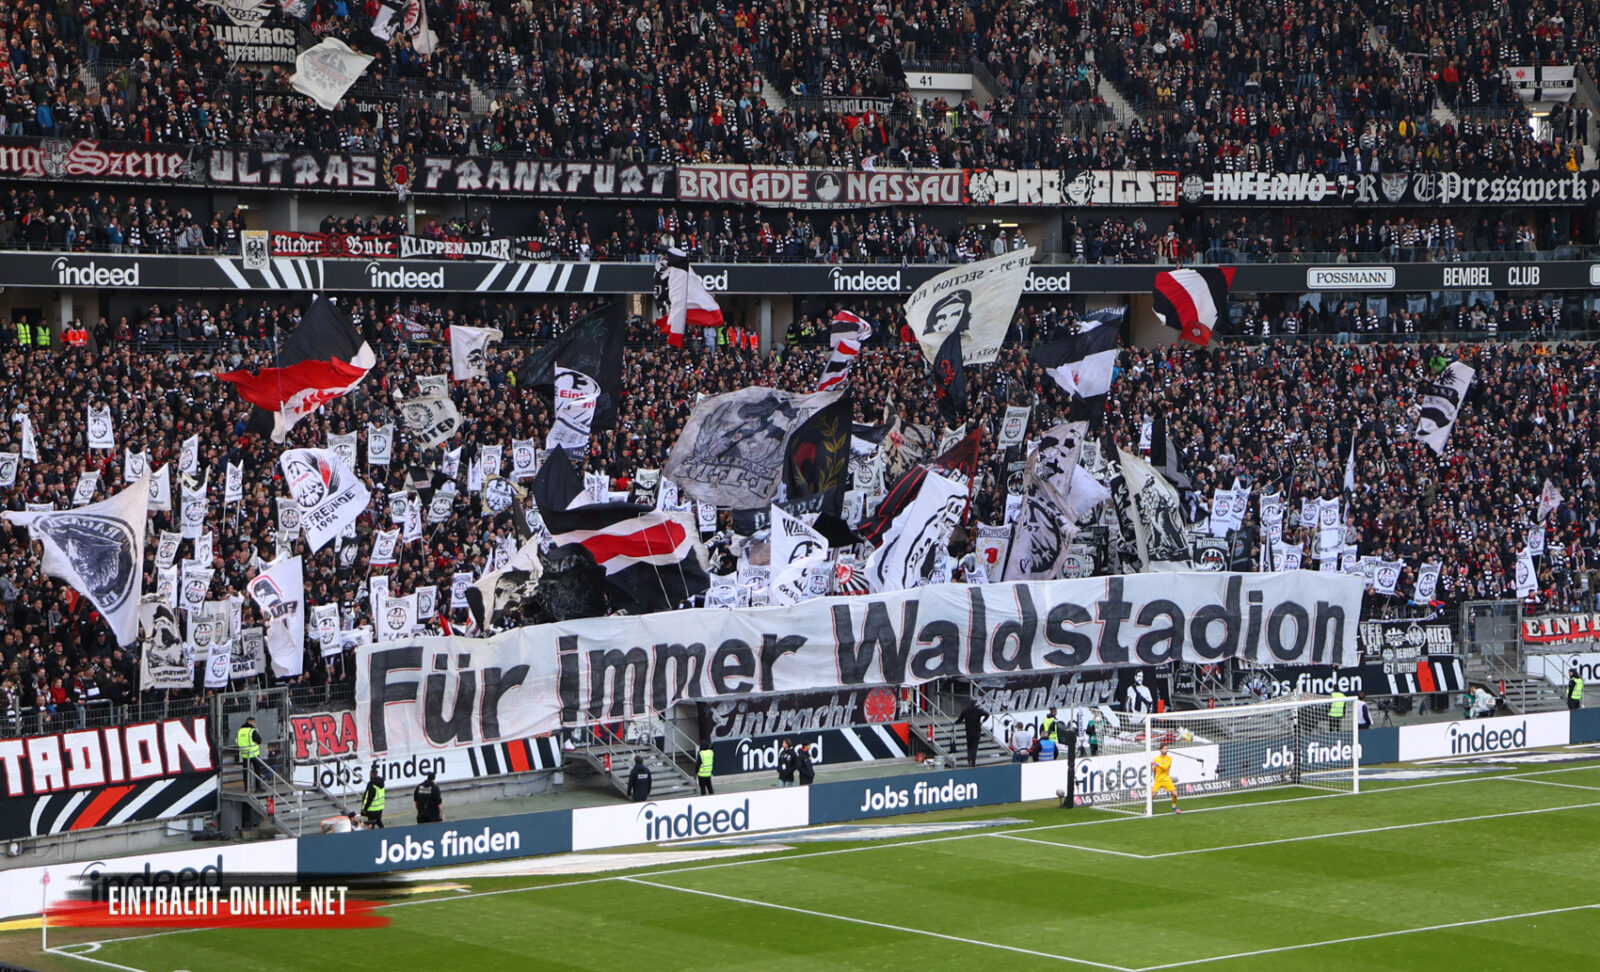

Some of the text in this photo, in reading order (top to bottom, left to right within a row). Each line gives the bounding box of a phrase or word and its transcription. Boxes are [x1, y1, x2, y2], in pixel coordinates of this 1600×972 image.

[227, 46, 296, 64] AFFENBURG
[920, 75, 934, 88] 41
[68, 138, 185, 180] Szene
[209, 149, 673, 195] ULTRAS FRANKFURT
[679, 169, 960, 205] BRIGADE NASSAU
[1156, 182, 1177, 201] 99
[1213, 171, 1327, 201] INFERNO
[1436, 170, 1588, 204] Presswerk
[273, 234, 323, 253] Nieder
[399, 235, 510, 261] KLIPPENADLER
[57, 261, 140, 287] indeed
[370, 265, 445, 290] indeed
[833, 269, 901, 291] indeed
[1024, 271, 1071, 292] deed
[1316, 271, 1388, 284] POSSMANN
[1442, 265, 1541, 287] BEMBEL CLUB
[308, 489, 356, 526] FREUNDE
[315, 513, 339, 532] 1994
[1426, 627, 1453, 643] RIED
[1428, 643, 1453, 654] GEBIET
[366, 574, 1346, 757] Für immer Waldstadion
[1297, 671, 1363, 695] finden
[710, 691, 858, 740] Eintracht
[1450, 720, 1527, 755] indeed
[1306, 739, 1363, 764] finden
[312, 754, 446, 790] Jobs finden
[1079, 760, 1152, 794] indee
[860, 779, 979, 812] Jobs finden
[644, 798, 749, 842] indeed
[375, 826, 521, 865] Jobs finden
